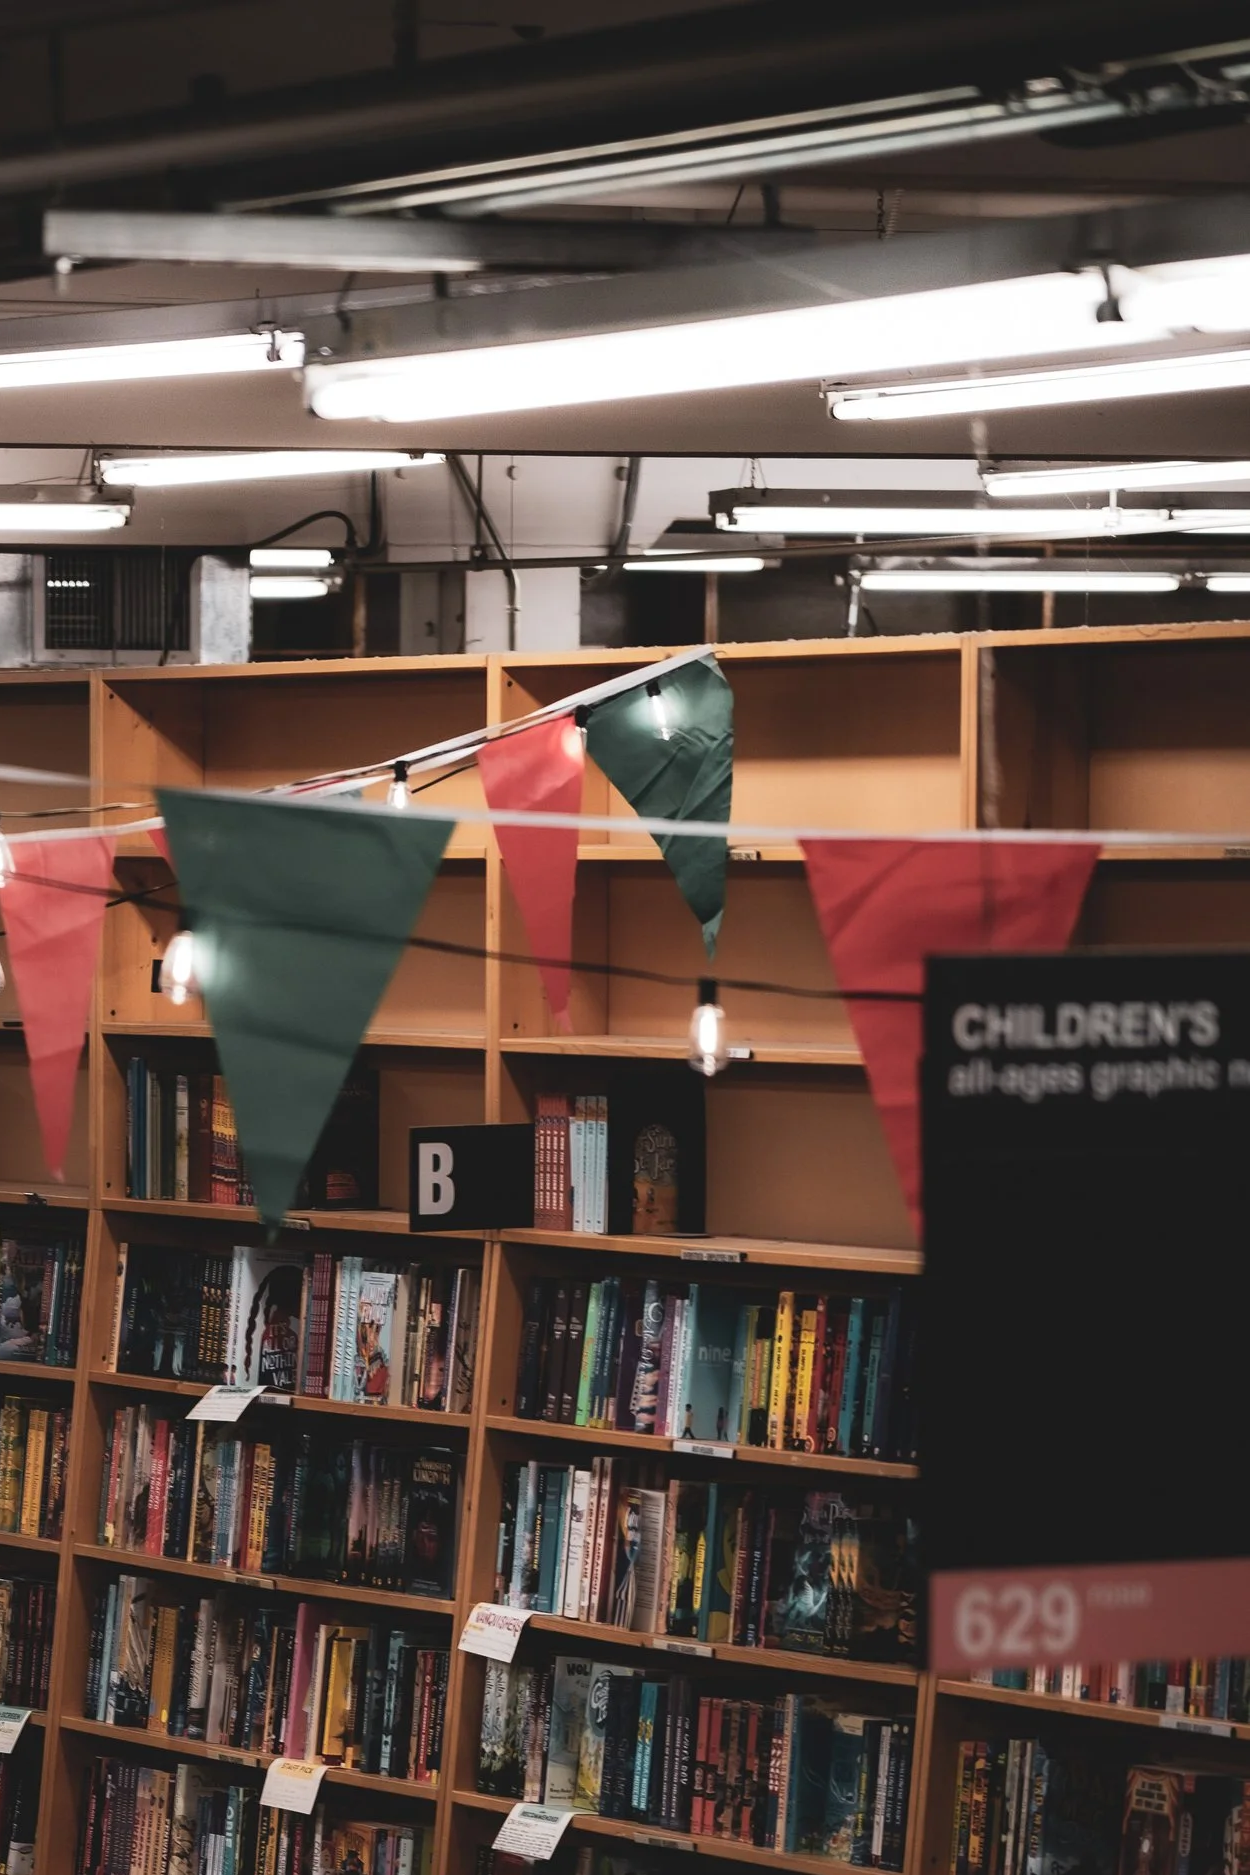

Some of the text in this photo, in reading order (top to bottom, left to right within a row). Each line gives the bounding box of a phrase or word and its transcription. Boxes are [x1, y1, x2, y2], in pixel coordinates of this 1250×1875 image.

[952, 1001, 1219, 1053] CHILDREN'S
[948, 1057, 1084, 1103] all-ages
[1091, 1054, 1218, 1102] graphic
[418, 1142, 456, 1215] B
[343, 1286, 357, 1377] ALMOST FLYING
[698, 1344, 732, 1362] nine
[411, 1469, 452, 1487] KINGDOM
[532, 1514, 543, 1571] VANQUISHERS
[597, 1502, 607, 1539] CIRCUS
[475, 1611, 521, 1638] VANQUISHERS
[954, 1583, 1081, 1660] 629
[567, 1663, 590, 1678] WOL
[130, 1811, 140, 1869] TAKEOUT
[161, 1819, 171, 1860] FENWAY
